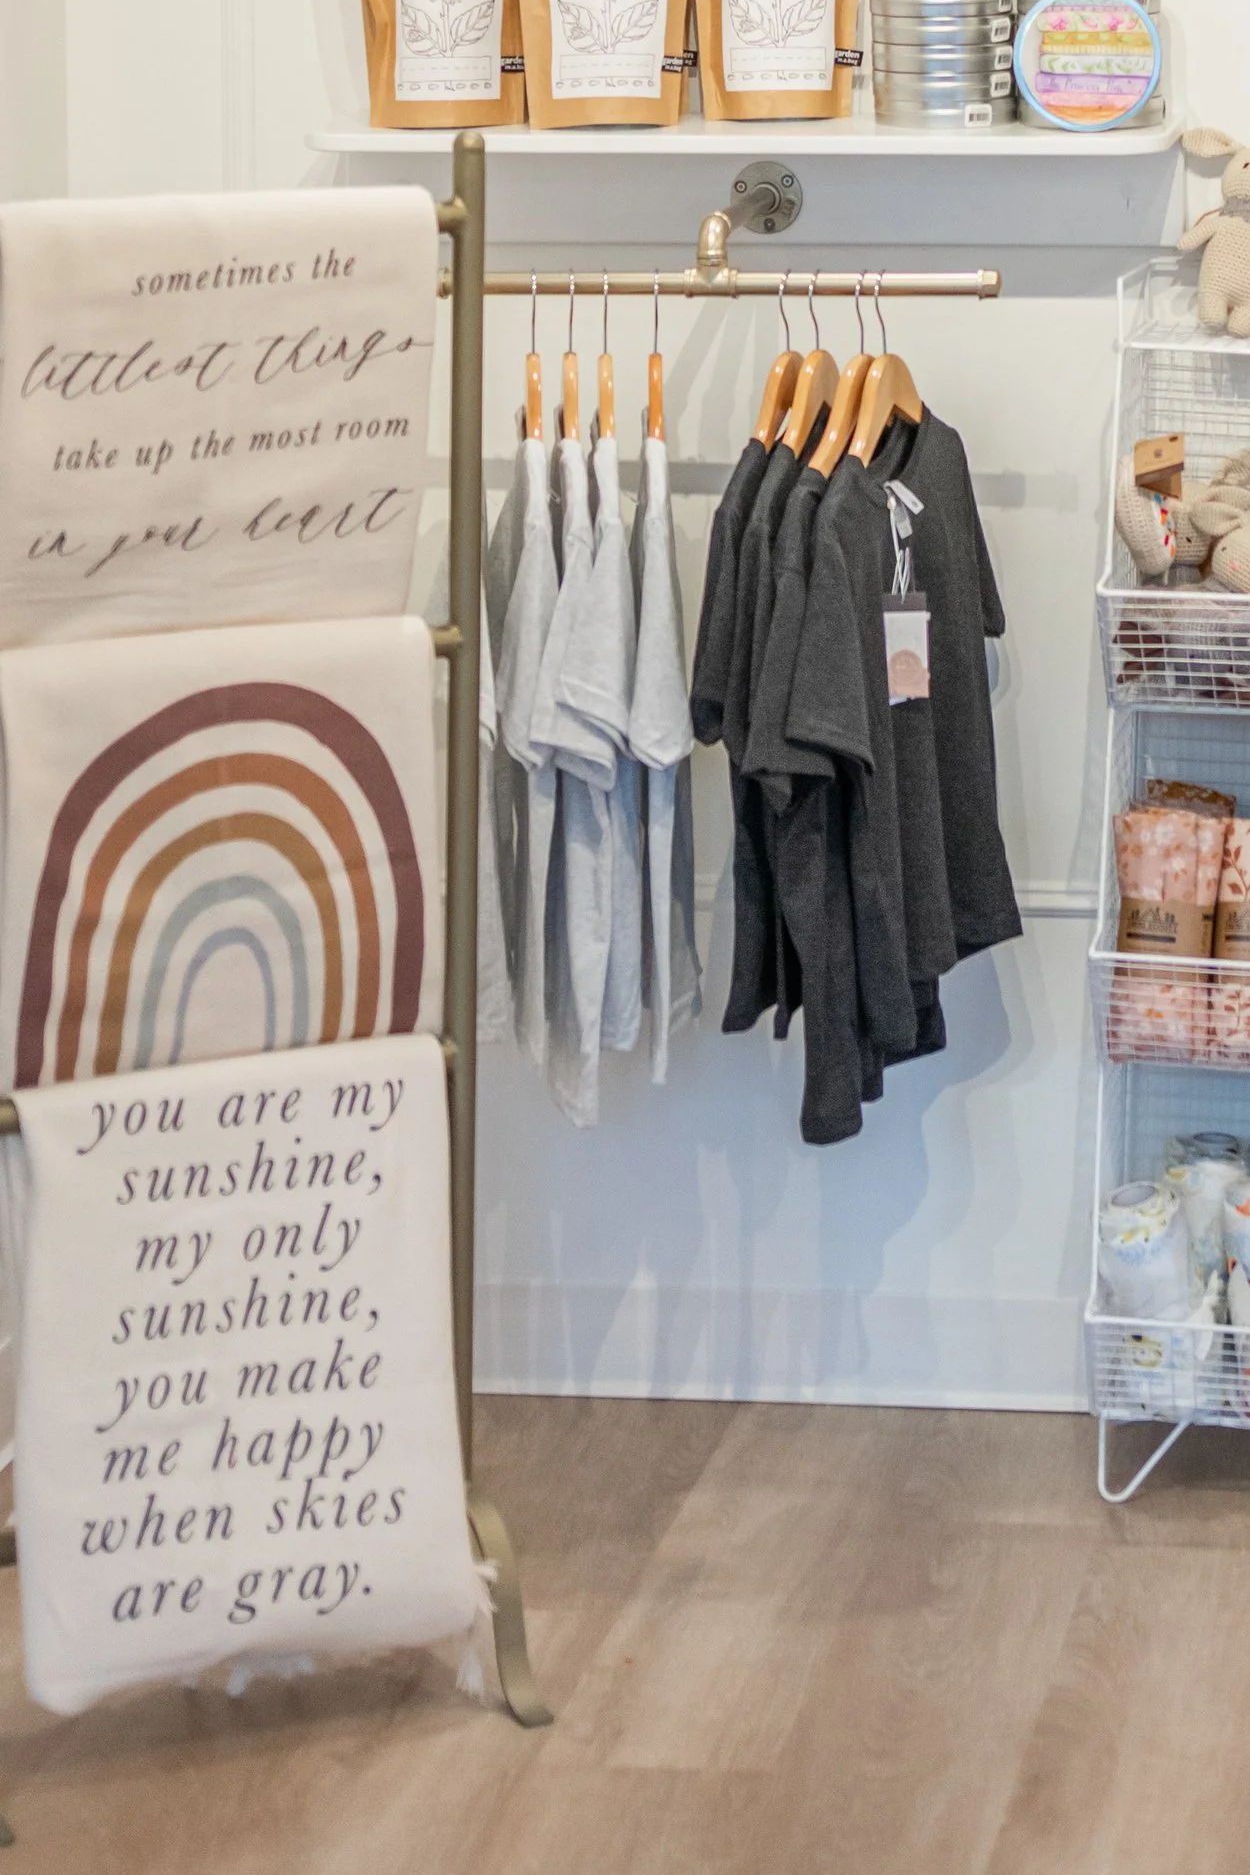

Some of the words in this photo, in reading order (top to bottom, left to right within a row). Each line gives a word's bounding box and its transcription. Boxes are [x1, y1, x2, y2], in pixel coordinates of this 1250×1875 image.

[500, 56, 524, 66] garde
[132, 256, 296, 297] sometimes
[312, 247, 356, 279] the
[20, 339, 241, 400] littlest
[254, 326, 434, 382] things
[53, 438, 119, 472] take
[135, 439, 174, 475] up
[190, 429, 235, 461] the
[249, 420, 321, 453] most
[335, 415, 409, 441] room
[27, 530, 85, 560] in
[86, 515, 218, 579] your
[243, 487, 413, 544] heart
[76, 1097, 185, 1156] you
[217, 1087, 303, 1126] are
[332, 1078, 405, 1132] my
[116, 1137, 383, 1206] sunshine,
[135, 1229, 214, 1285] my
[242, 1202, 361, 1272] only
[112, 1272, 380, 1345] sunshine,
[95, 1367, 208, 1433] you
[237, 1338, 383, 1399] make
[102, 1438, 182, 1484] me
[211, 1415, 385, 1482] happy
[81, 1493, 234, 1556] when
[266, 1476, 406, 1532] skies
[112, 1576, 203, 1623] are
[227, 1560, 373, 1625] gray.
